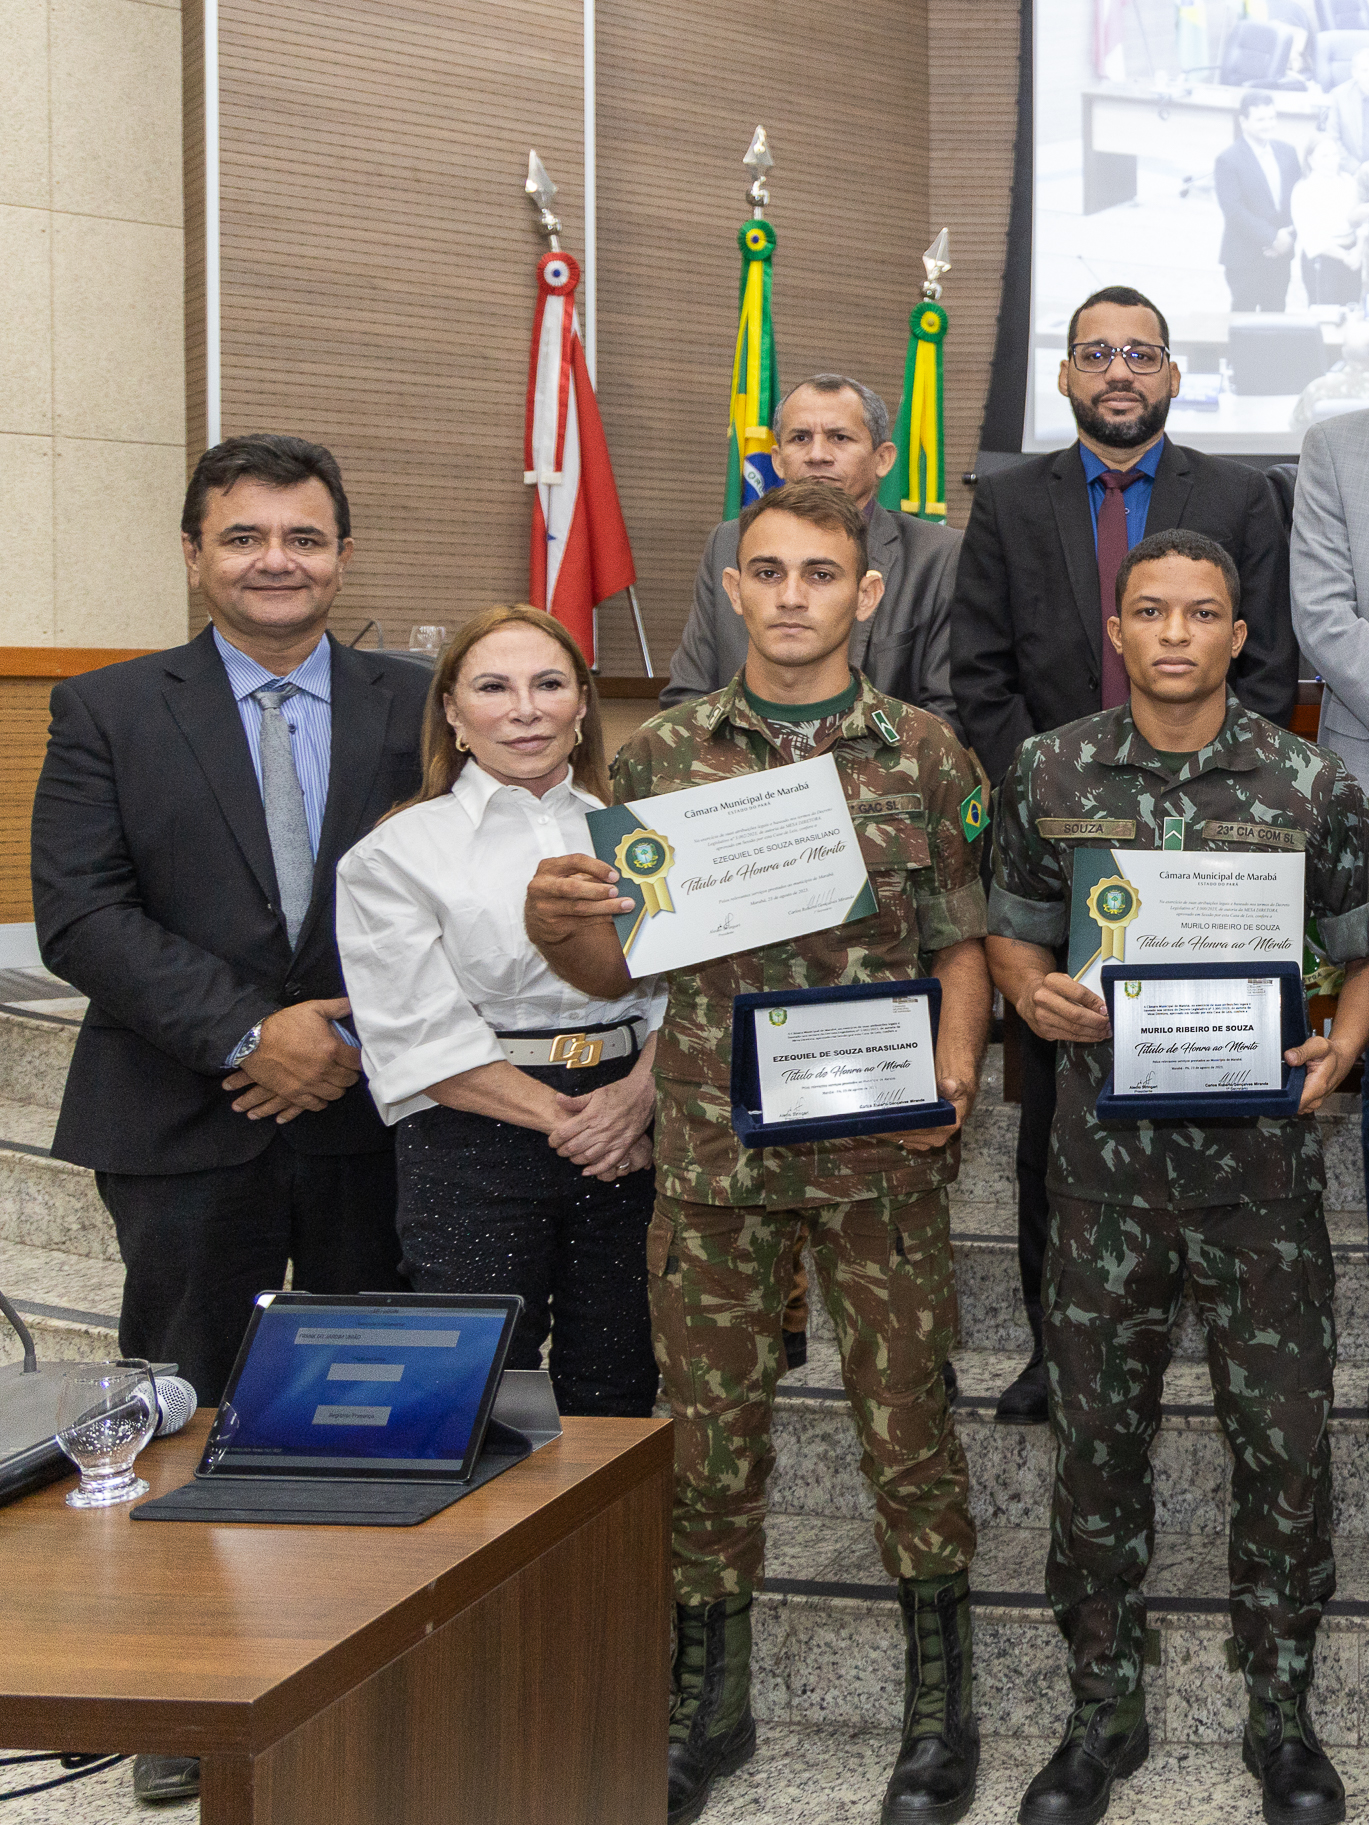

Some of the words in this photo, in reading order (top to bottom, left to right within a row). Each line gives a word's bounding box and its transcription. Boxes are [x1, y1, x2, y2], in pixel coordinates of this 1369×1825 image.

[684, 806, 719, 819] Câmara
[720, 793, 763, 810] Municipal
[764, 791, 776, 800] de
[777, 782, 810, 796] Marabá
[858, 802, 883, 813] GAC
[886, 800, 899, 811] SL
[1064, 823, 1105, 835] SOUZA
[1236, 826, 1255, 841] CIA
[1257, 828, 1281, 843] COM
[1283, 832, 1295, 845] SL
[712, 850, 753, 865] EZEQUIEL
[753, 846, 765, 856] DE
[766, 840, 794, 852] SOUZA
[794, 828, 841, 846] BRASILIANO
[680, 874, 717, 896] Título
[719, 870, 734, 884] de
[736, 861, 779, 881] Honra
[782, 858, 798, 868] ao
[799, 840, 846, 864] Mérito
[1159, 871, 1191, 880] Câmara
[1192, 872, 1233, 882] Municipal
[1234, 872, 1246, 881] de
[1246, 872, 1277, 881] Marabá
[1180, 922, 1211, 930] MURILO
[1211, 922, 1242, 931] RIBEIRO
[1243, 923, 1254, 931] DE
[1255, 924, 1281, 932] SOUZA
[1136, 934, 1170, 950] Título
[1170, 936, 1185, 948] de
[1187, 935, 1229, 951] Honra
[1248, 936, 1292, 953] Mérito
[1140, 1026, 1174, 1034] MURILO
[1175, 1025, 1210, 1033] RIBEIRO
[1212, 1025, 1224, 1033] DE
[1225, 1024, 1255, 1032] SOUZA
[772, 1052, 817, 1063] EZEQUIEL
[819, 1050, 832, 1058] DE
[833, 1047, 864, 1057] SOUZA
[865, 1042, 919, 1053] BRASILIANO
[1134, 1042, 1165, 1057] Título
[1165, 1042, 1179, 1054] de
[1180, 1042, 1211, 1055] Honra
[1224, 1040, 1259, 1053] Mérito
[781, 1068, 814, 1084] Título
[814, 1066, 829, 1079] de
[830, 1064, 863, 1077] Honra
[876, 1059, 911, 1073] Mérito
